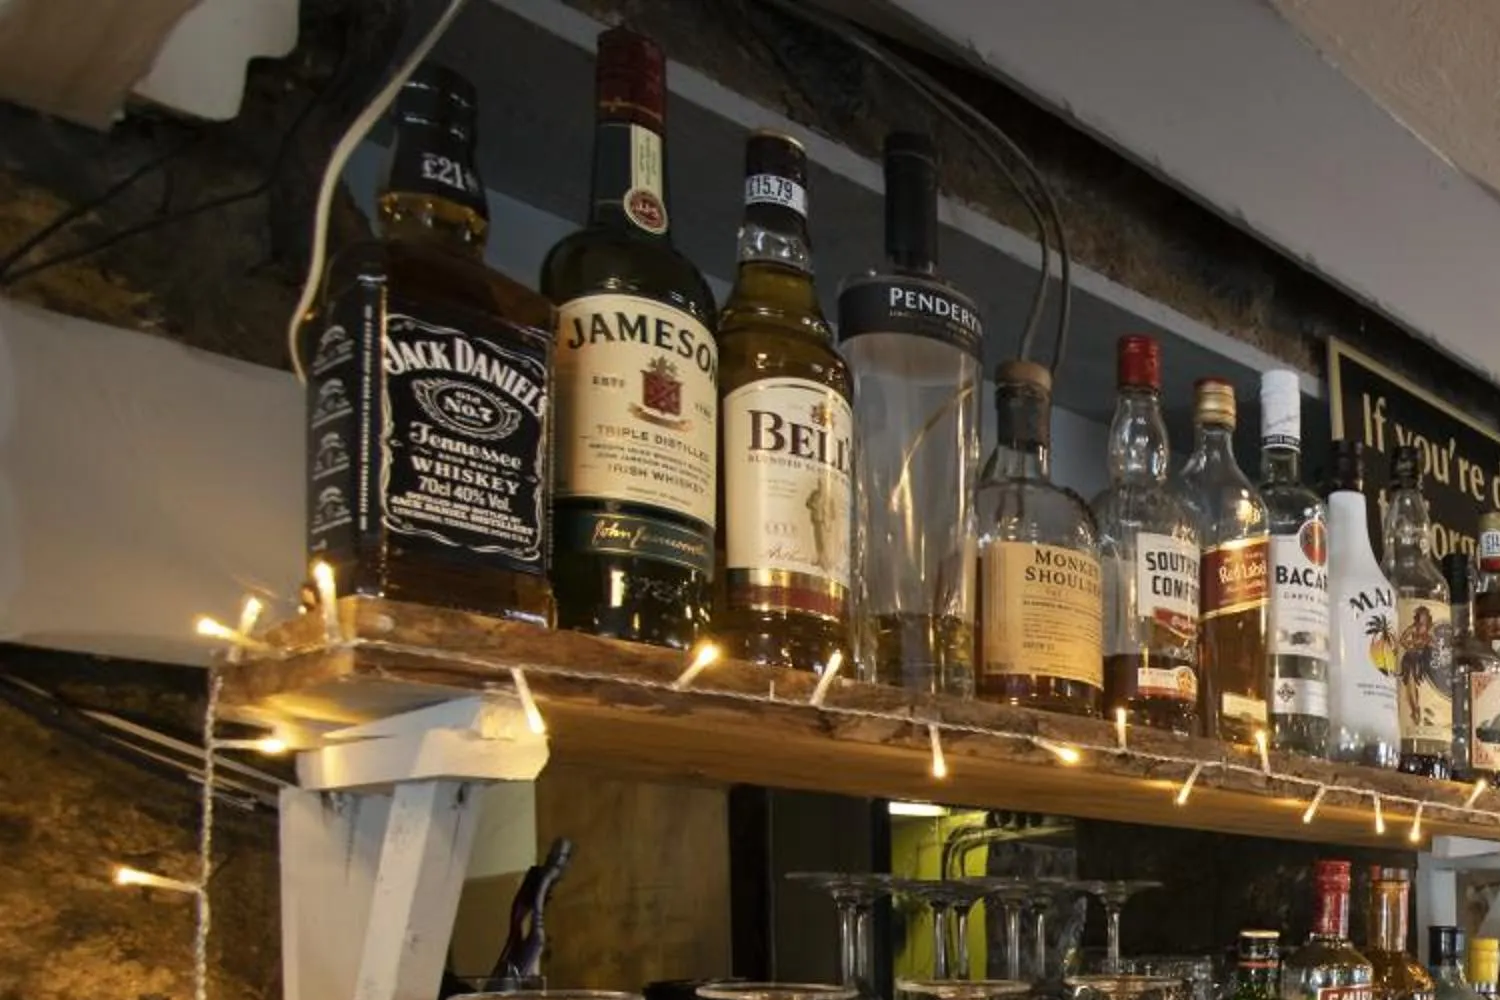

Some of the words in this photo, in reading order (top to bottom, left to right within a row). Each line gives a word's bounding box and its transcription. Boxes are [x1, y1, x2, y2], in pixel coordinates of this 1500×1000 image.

[385, 336, 452, 375] JACK
[455, 337, 548, 417] DANIEL'S
[409, 421, 522, 470] Tennessee
[596, 424, 649, 442] TRIPLE
[747, 409, 849, 475] BELL'
[1363, 393, 1387, 452] If
[410, 455, 520, 496] WHISKEY
